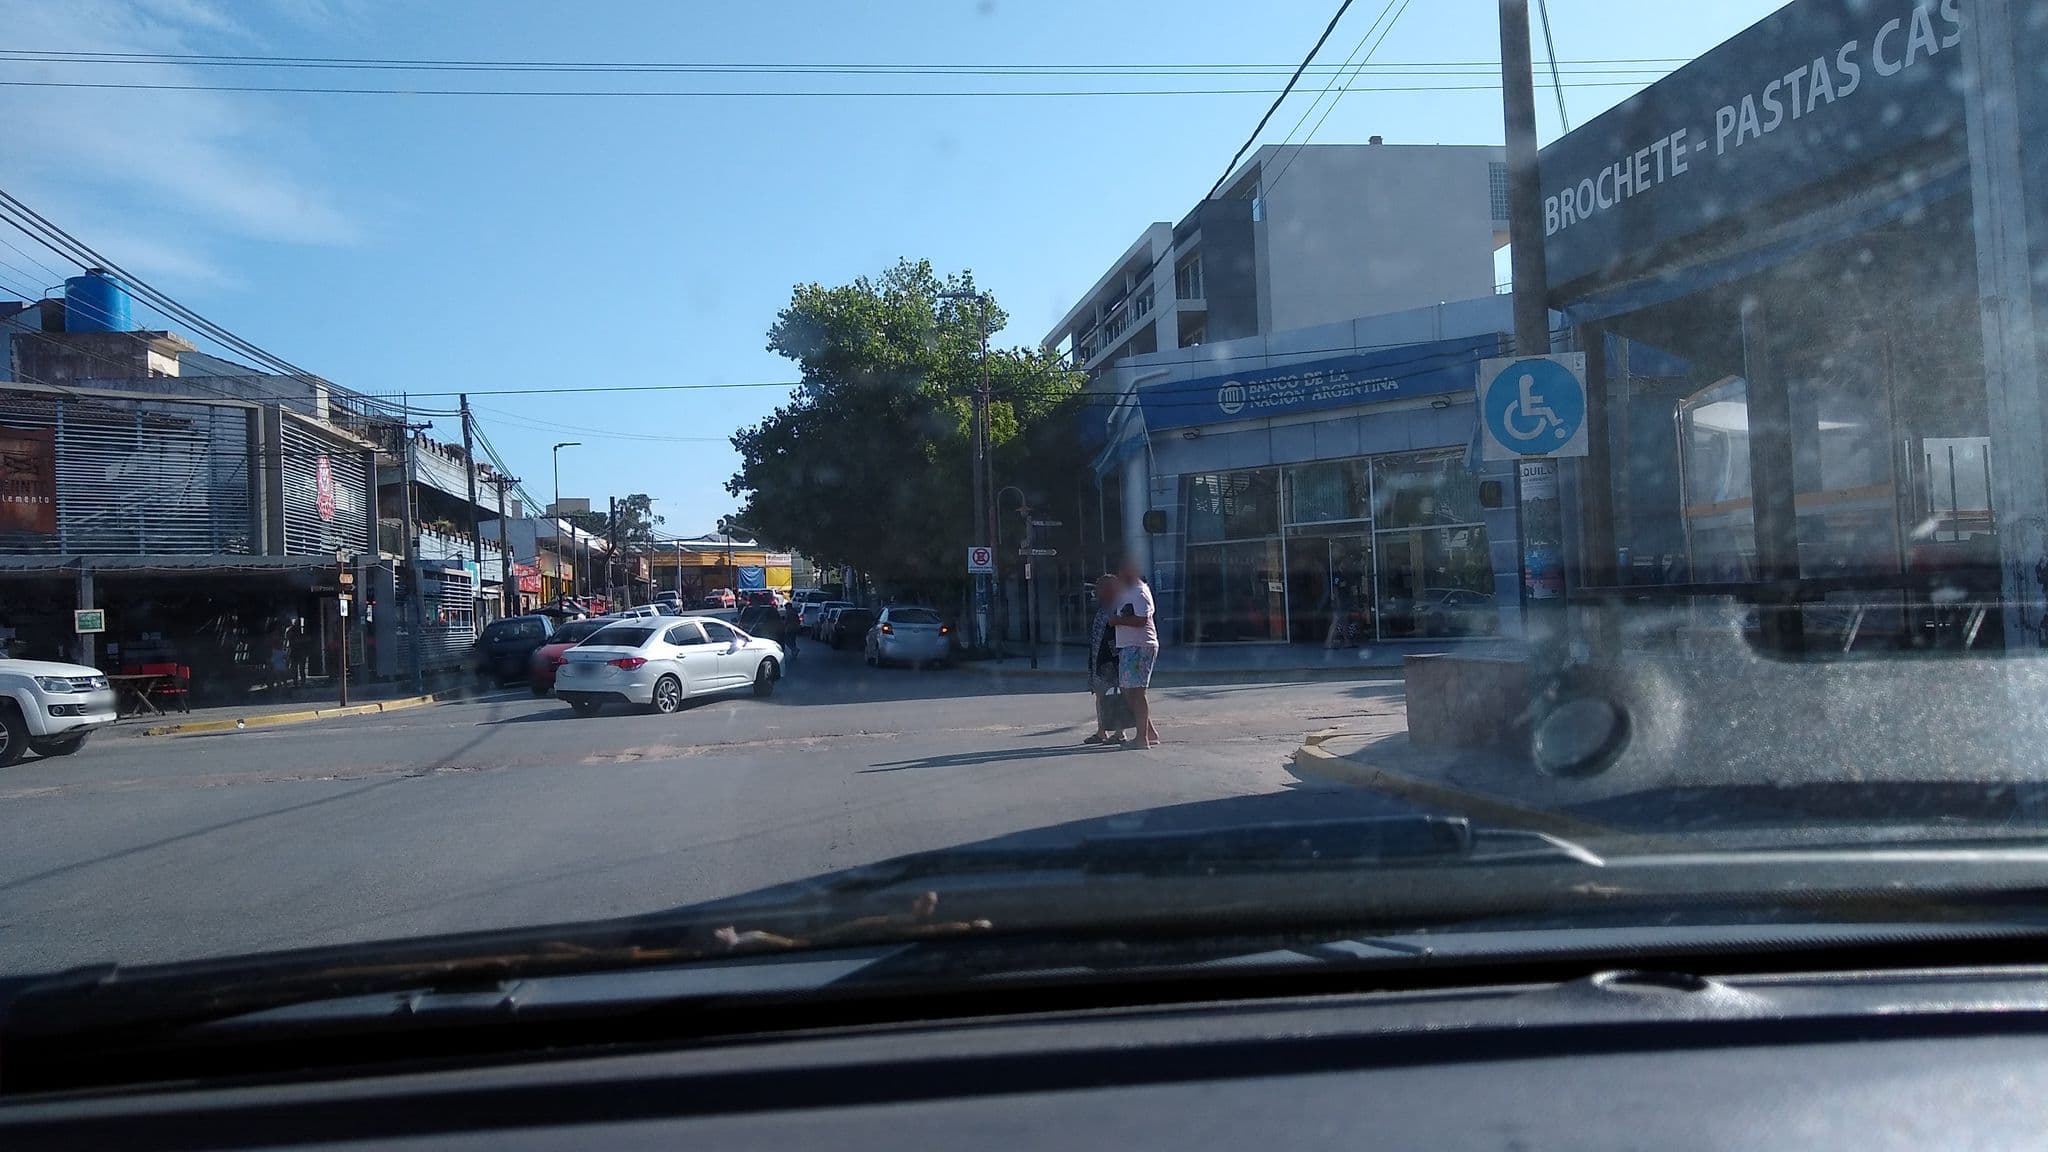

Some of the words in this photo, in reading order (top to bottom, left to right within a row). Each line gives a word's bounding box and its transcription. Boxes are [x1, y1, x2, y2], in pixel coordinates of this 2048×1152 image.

[1544, 126, 1689, 237] BROCHETE
[1696, 140, 1708, 152] -
[1715, 40, 1862, 156] PASTAS
[1249, 375, 1298, 394] BANCO
[1303, 371, 1324, 387] DE
[1328, 368, 1350, 383] LA
[1311, 376, 1399, 401] ARGENTINA
